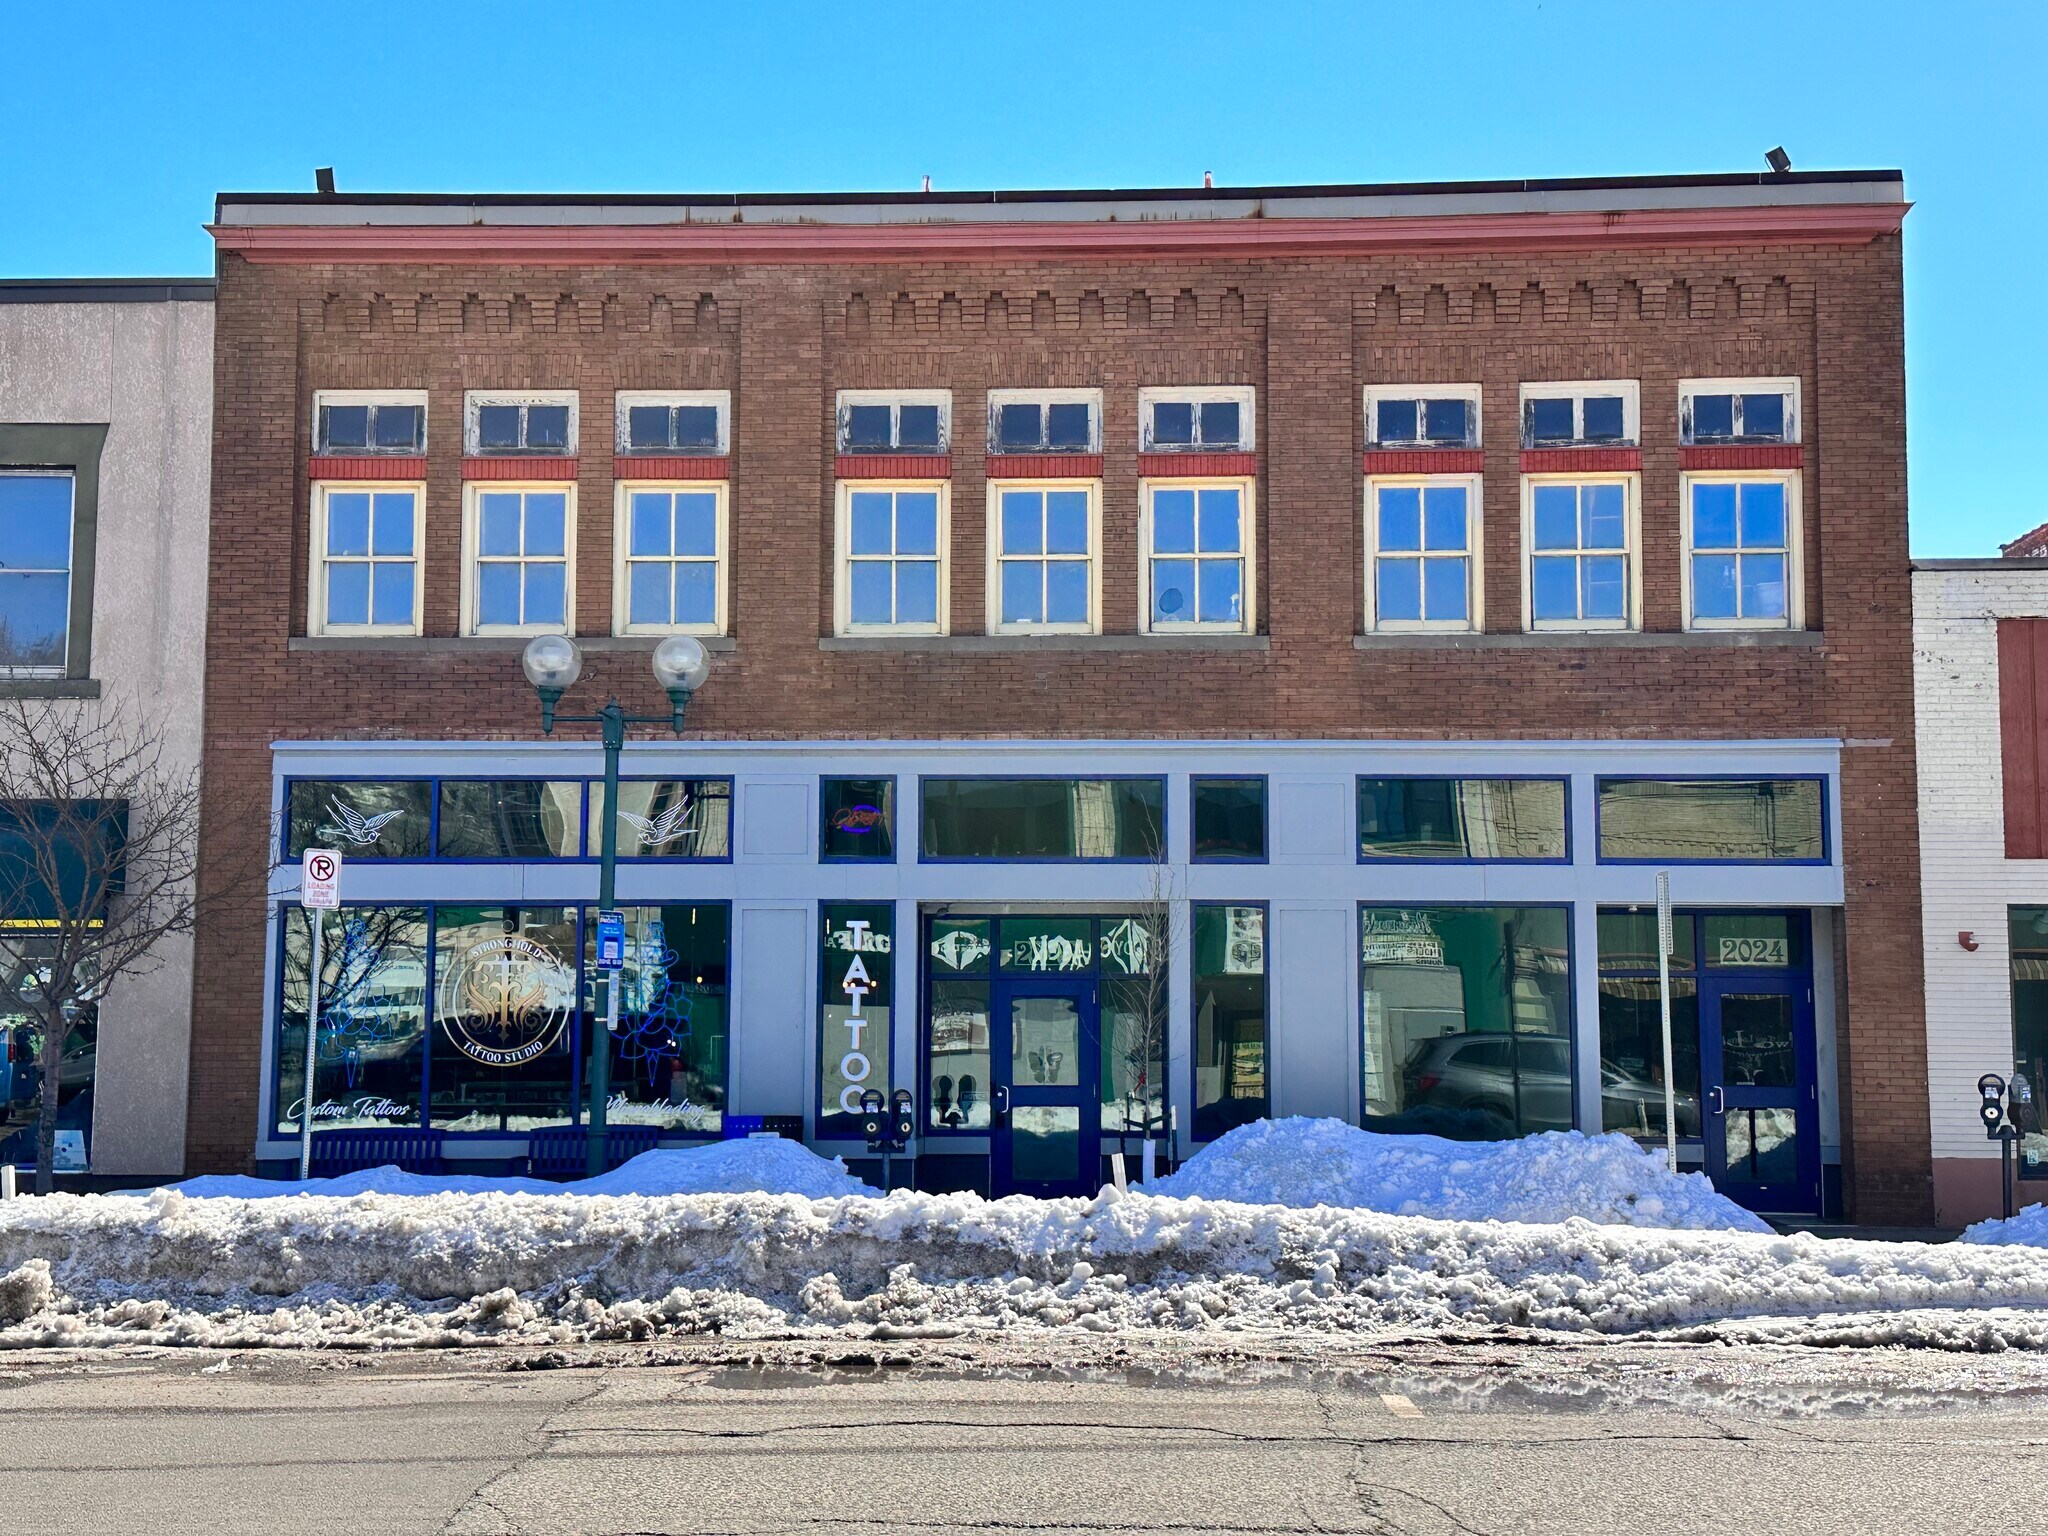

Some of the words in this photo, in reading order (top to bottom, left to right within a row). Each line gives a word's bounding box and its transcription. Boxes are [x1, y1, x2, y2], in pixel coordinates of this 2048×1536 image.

[471, 938, 543, 958] STRONGHOLD
[1721, 938, 1785, 964] 2024
[840, 920, 871, 1114] TATTOO
[463, 1040, 502, 1063] TATTOO
[504, 1040, 543, 1063] STUDIO
[353, 1096, 411, 1119] Tattoos
